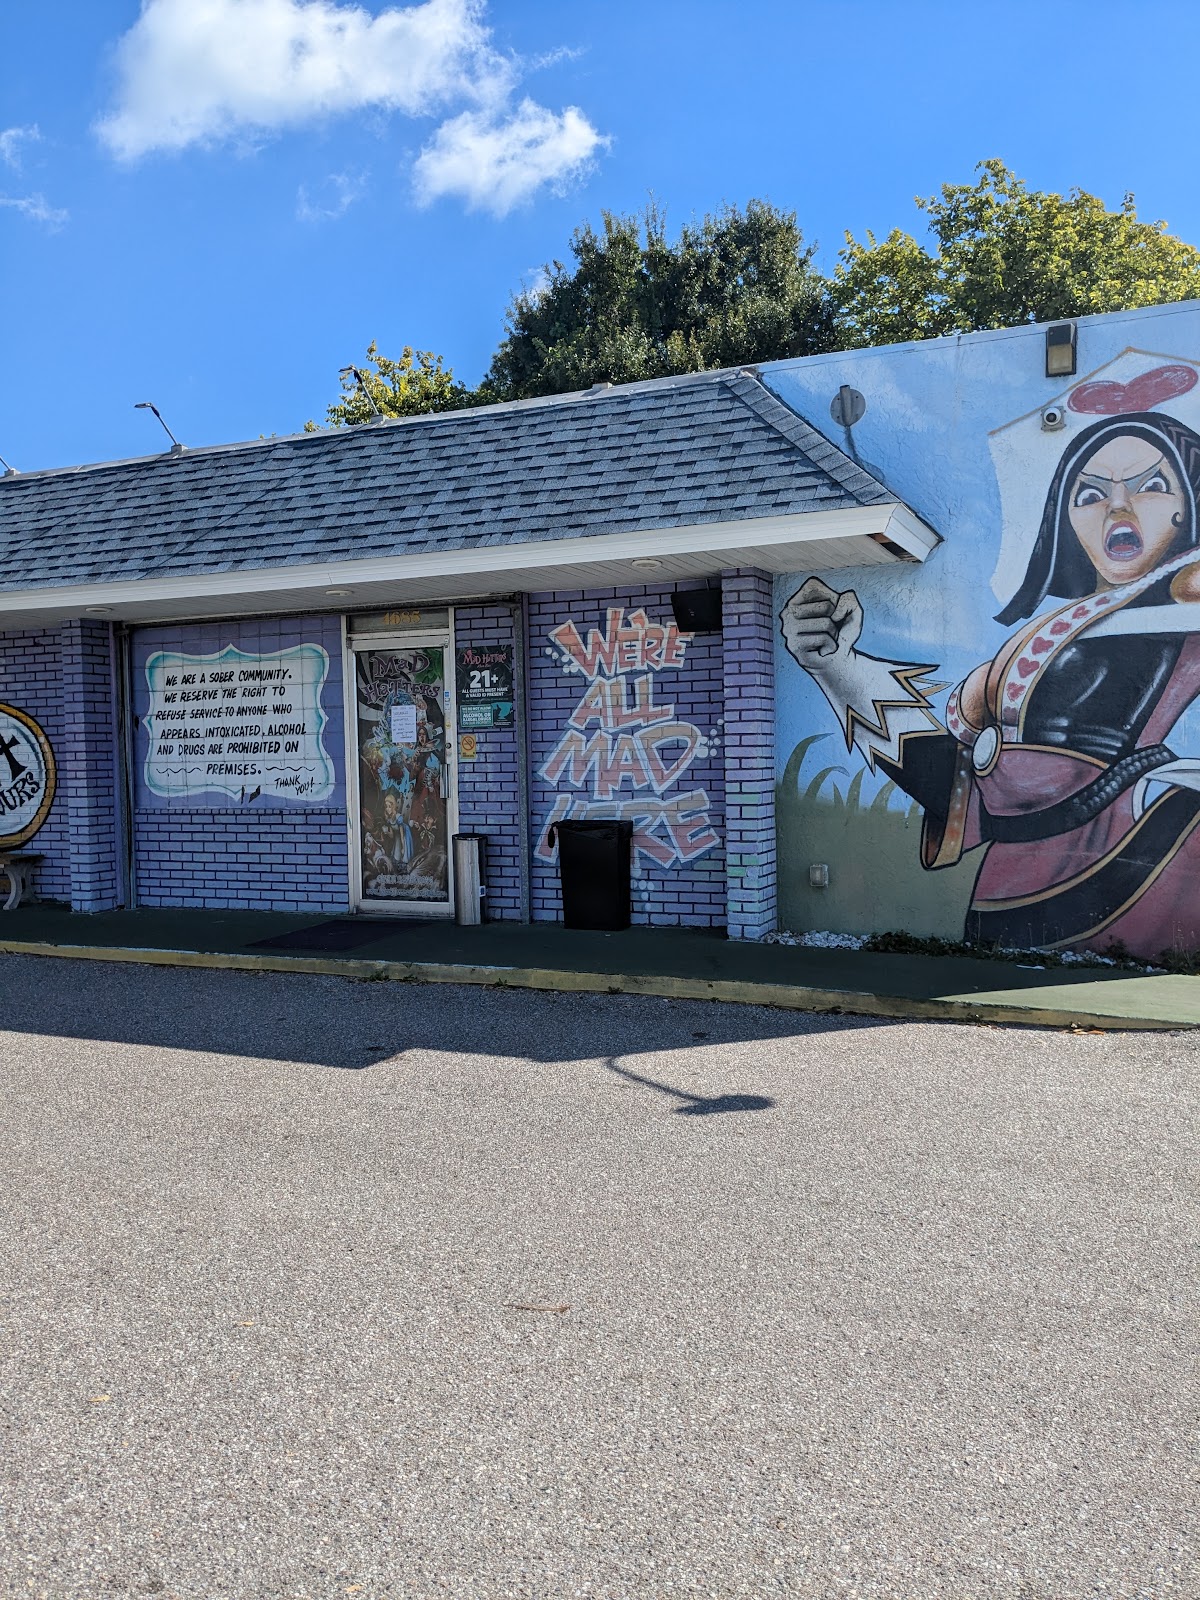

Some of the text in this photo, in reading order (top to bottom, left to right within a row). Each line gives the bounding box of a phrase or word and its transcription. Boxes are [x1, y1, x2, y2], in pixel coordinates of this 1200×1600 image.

[166, 668, 292, 686] WE ARE A SOBER COMMUNITY.
[469, 670, 498, 688] 21+
[164, 686, 286, 703] WE RESERVE THE RIGHT TO
[568, 672, 675, 731] ALL
[155, 703, 293, 721] REFUSE SERVICE TO ANYONE WHO
[160, 727, 201, 739] APPEARS
[267, 722, 307, 736] ALCOHOL
[157, 740, 299, 756] AND DRUGS ARE PROHIBITED ON
[206, 763, 262, 776] PREMISES.
[538, 721, 702, 800] MAD
[274, 775, 301, 789] THANK
[295, 776, 315, 796] YOU!
[0, 771, 41, 816] URS
